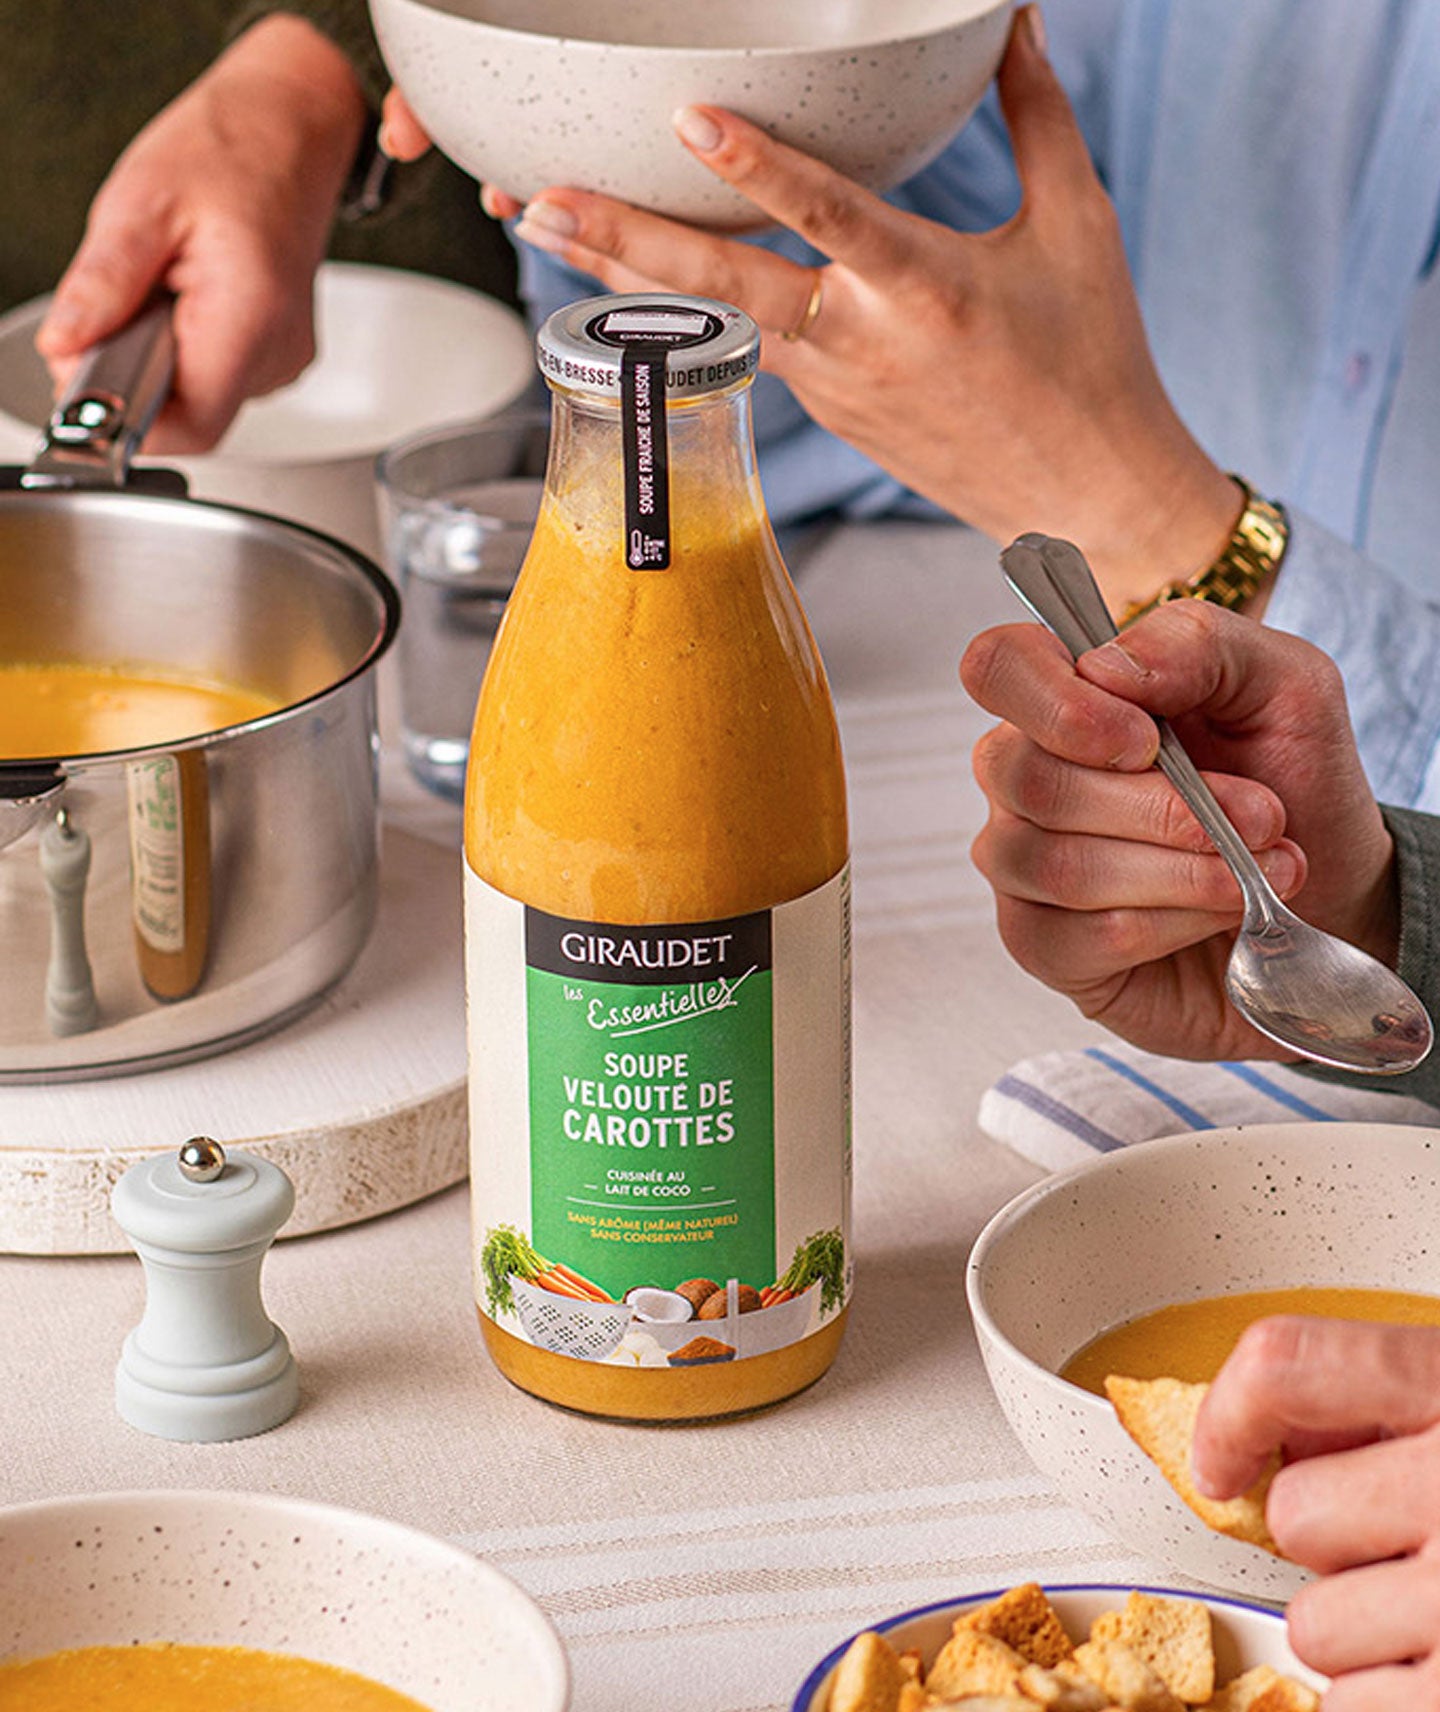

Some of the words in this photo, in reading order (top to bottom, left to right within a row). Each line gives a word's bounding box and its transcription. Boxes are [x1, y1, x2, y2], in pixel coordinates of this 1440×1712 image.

[634, 363, 650, 407] SAISON
[666, 367, 703, 388] UDET
[636, 408, 651, 424] DE
[638, 475, 654, 515] SOUPE
[560, 932, 733, 968] GIRAUDET
[563, 984, 583, 1001] les
[587, 967, 755, 1031] Essentielles
[604, 1052, 689, 1078] SOUPE
[563, 1076, 688, 1112] VELOUTÉ
[699, 1079, 734, 1109] DE
[563, 1108, 736, 1149] CAROTTES
[606, 1168, 663, 1183] CUISINÉE
[666, 1171, 685, 1182] AU
[605, 1184, 630, 1195] LAIT
[632, 1185, 649, 1196] DE
[652, 1185, 691, 1197] COCO
[567, 1211, 596, 1226] SANS
[599, 1217, 641, 1231] ARÔME
[590, 1229, 621, 1242] SANS
[623, 1230, 715, 1243] CONSERVATEUR
